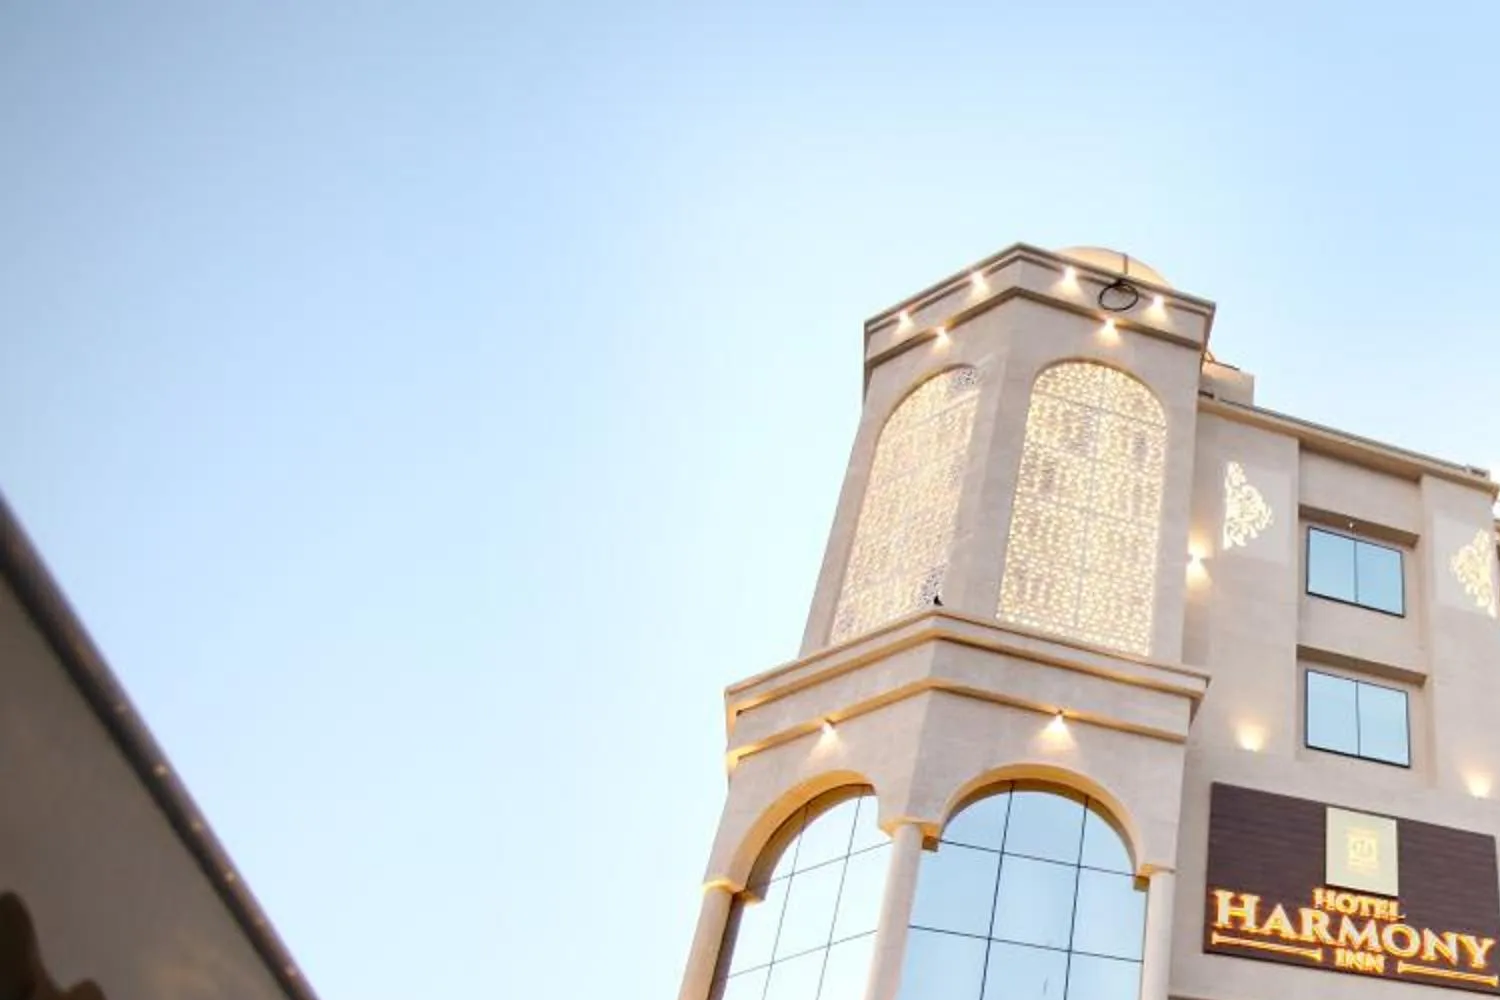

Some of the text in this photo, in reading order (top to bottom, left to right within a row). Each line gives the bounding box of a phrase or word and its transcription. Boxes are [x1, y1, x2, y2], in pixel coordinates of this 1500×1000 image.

[1312, 887, 1406, 920] HOTEL
[1211, 888, 1495, 969] HARMONY
[1335, 949, 1385, 974] INN
